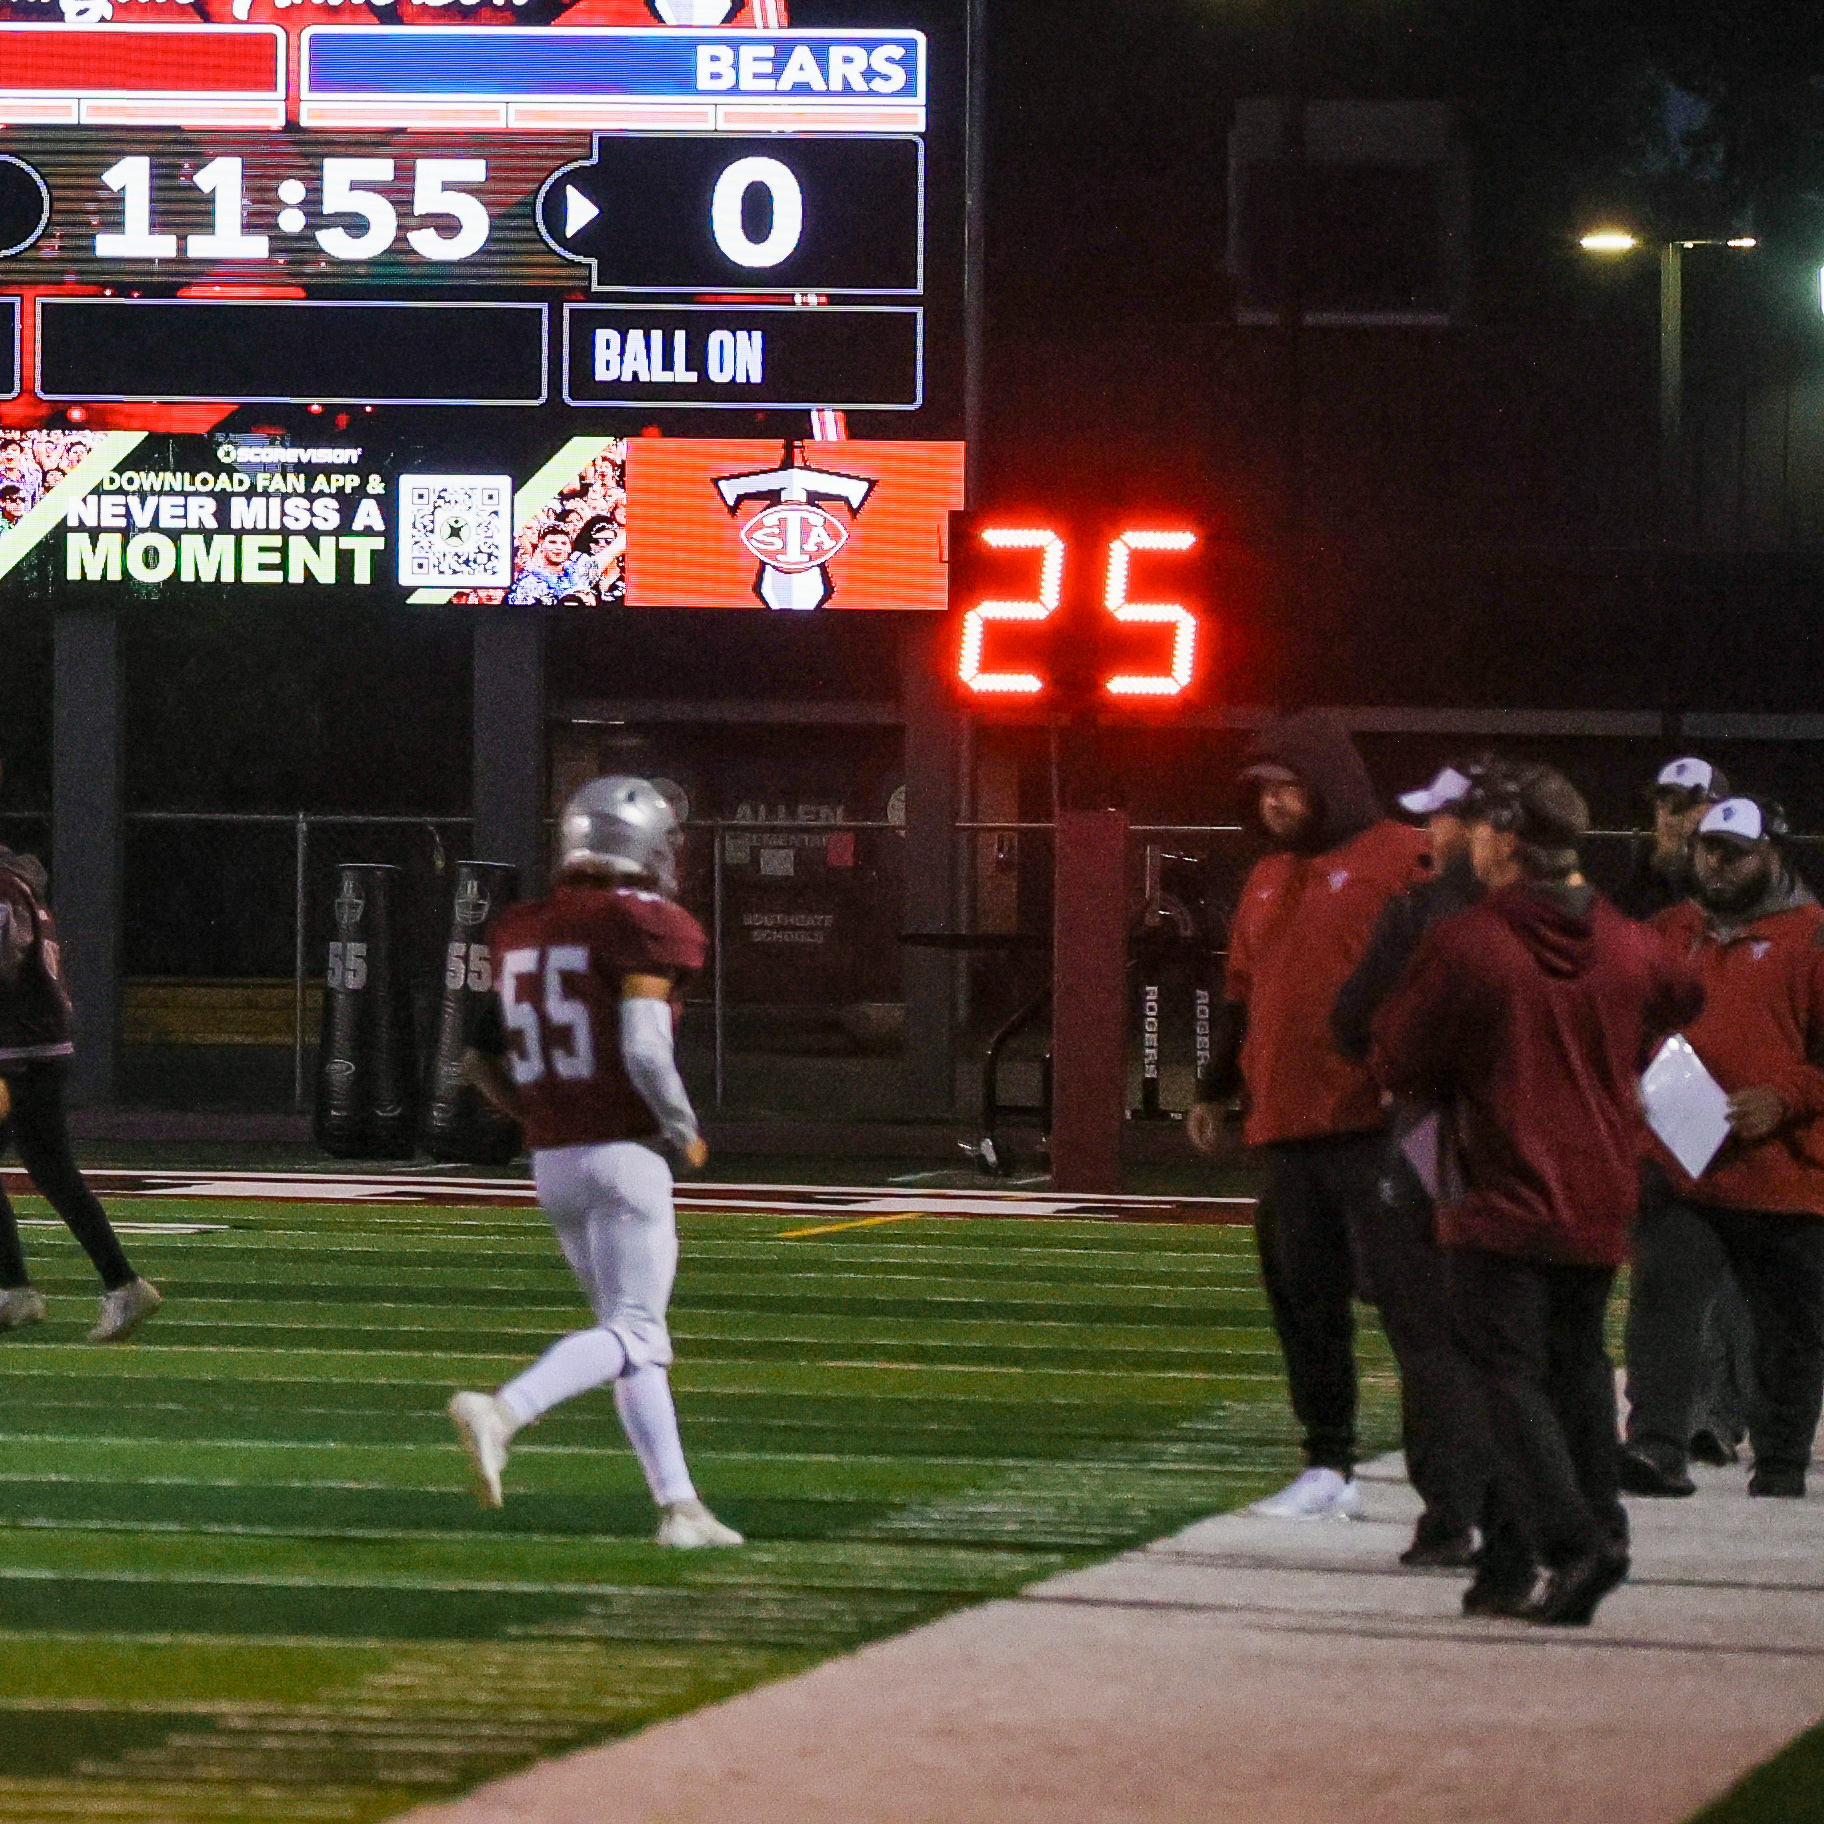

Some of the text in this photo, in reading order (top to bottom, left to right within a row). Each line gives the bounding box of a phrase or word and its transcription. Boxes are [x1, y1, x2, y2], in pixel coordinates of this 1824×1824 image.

[695, 44, 908, 94] BEARS
[94, 155, 491, 262] 11:55
[710, 155, 804, 269] 0
[592, 327, 765, 384] BALL ON
[66, 495, 386, 531] NEVER MISS A
[102, 471, 386, 495] DOWNLOAD FAN APP &
[66, 532, 386, 585] MOMENT
[958, 528, 1198, 695] 25
[502, 944, 595, 1085] 55
[1144, 984, 1159, 1079] ROGERS
